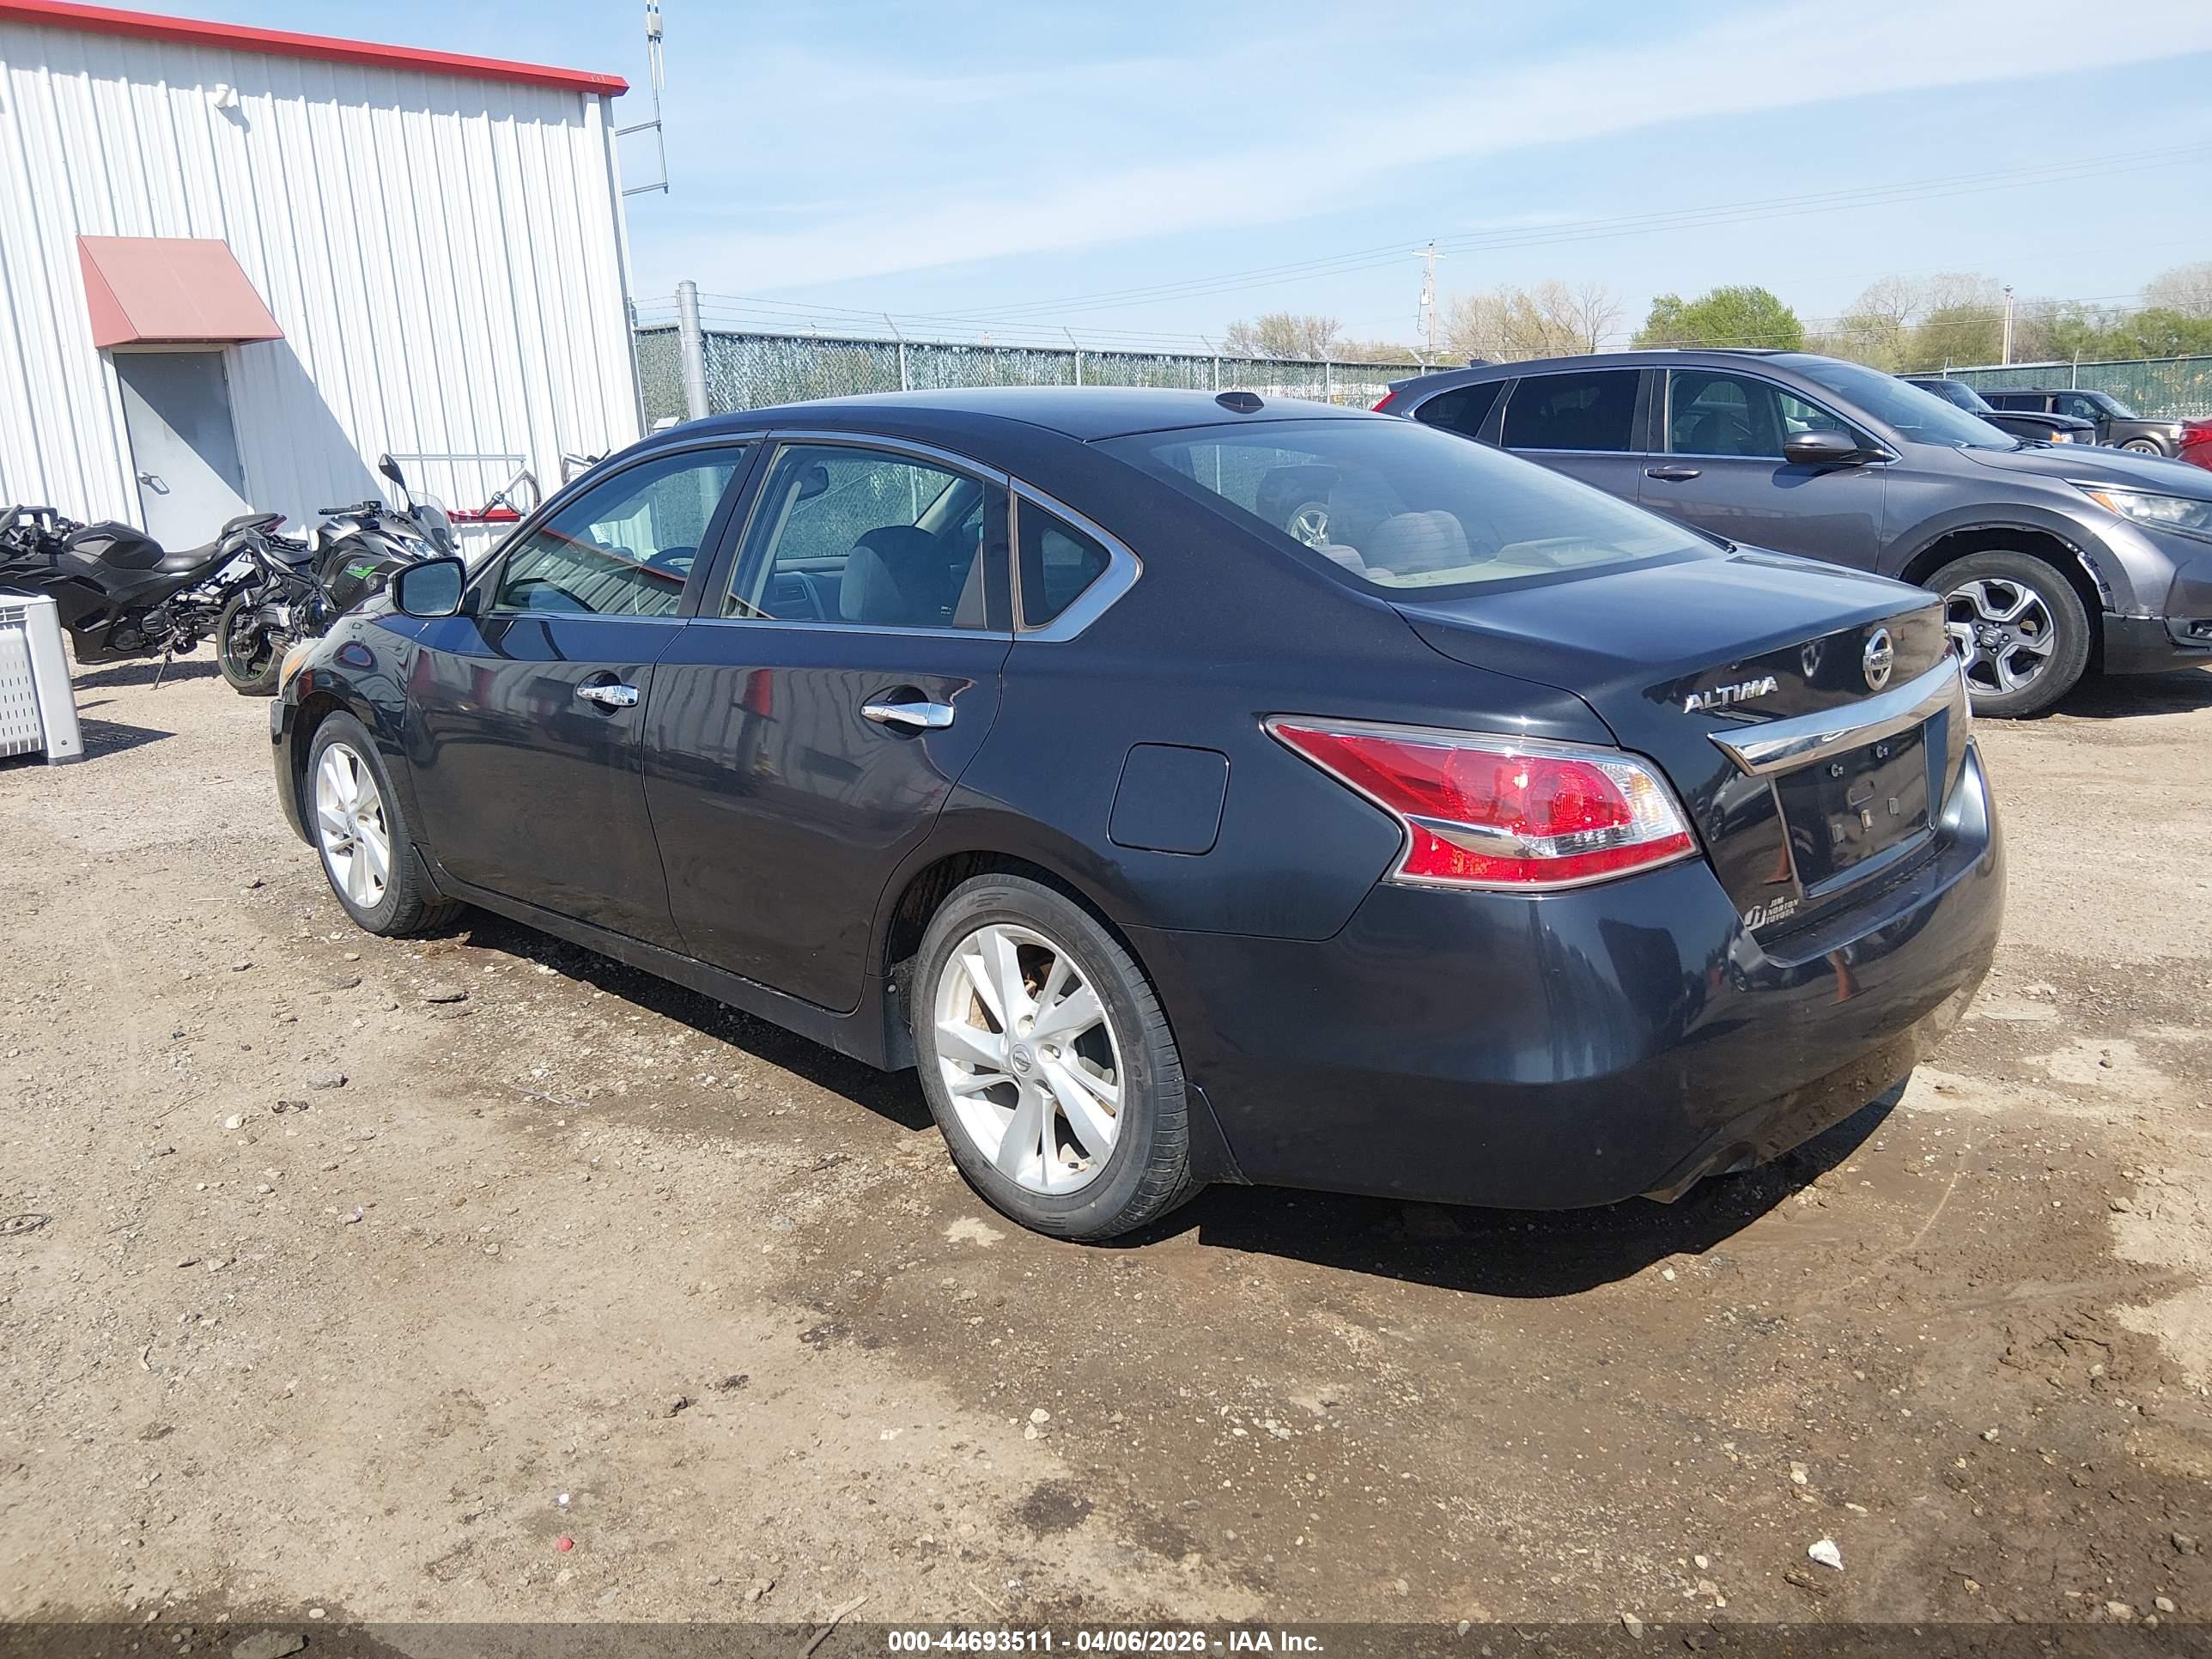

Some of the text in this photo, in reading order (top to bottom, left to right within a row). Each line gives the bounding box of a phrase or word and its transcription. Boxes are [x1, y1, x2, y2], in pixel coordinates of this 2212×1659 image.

[1683, 676, 1779, 714] ALTIMA
[1767, 898, 1800, 916] NORTON
[1769, 896, 1784, 908] JIM
[1765, 907, 1795, 924] TOYOTA
